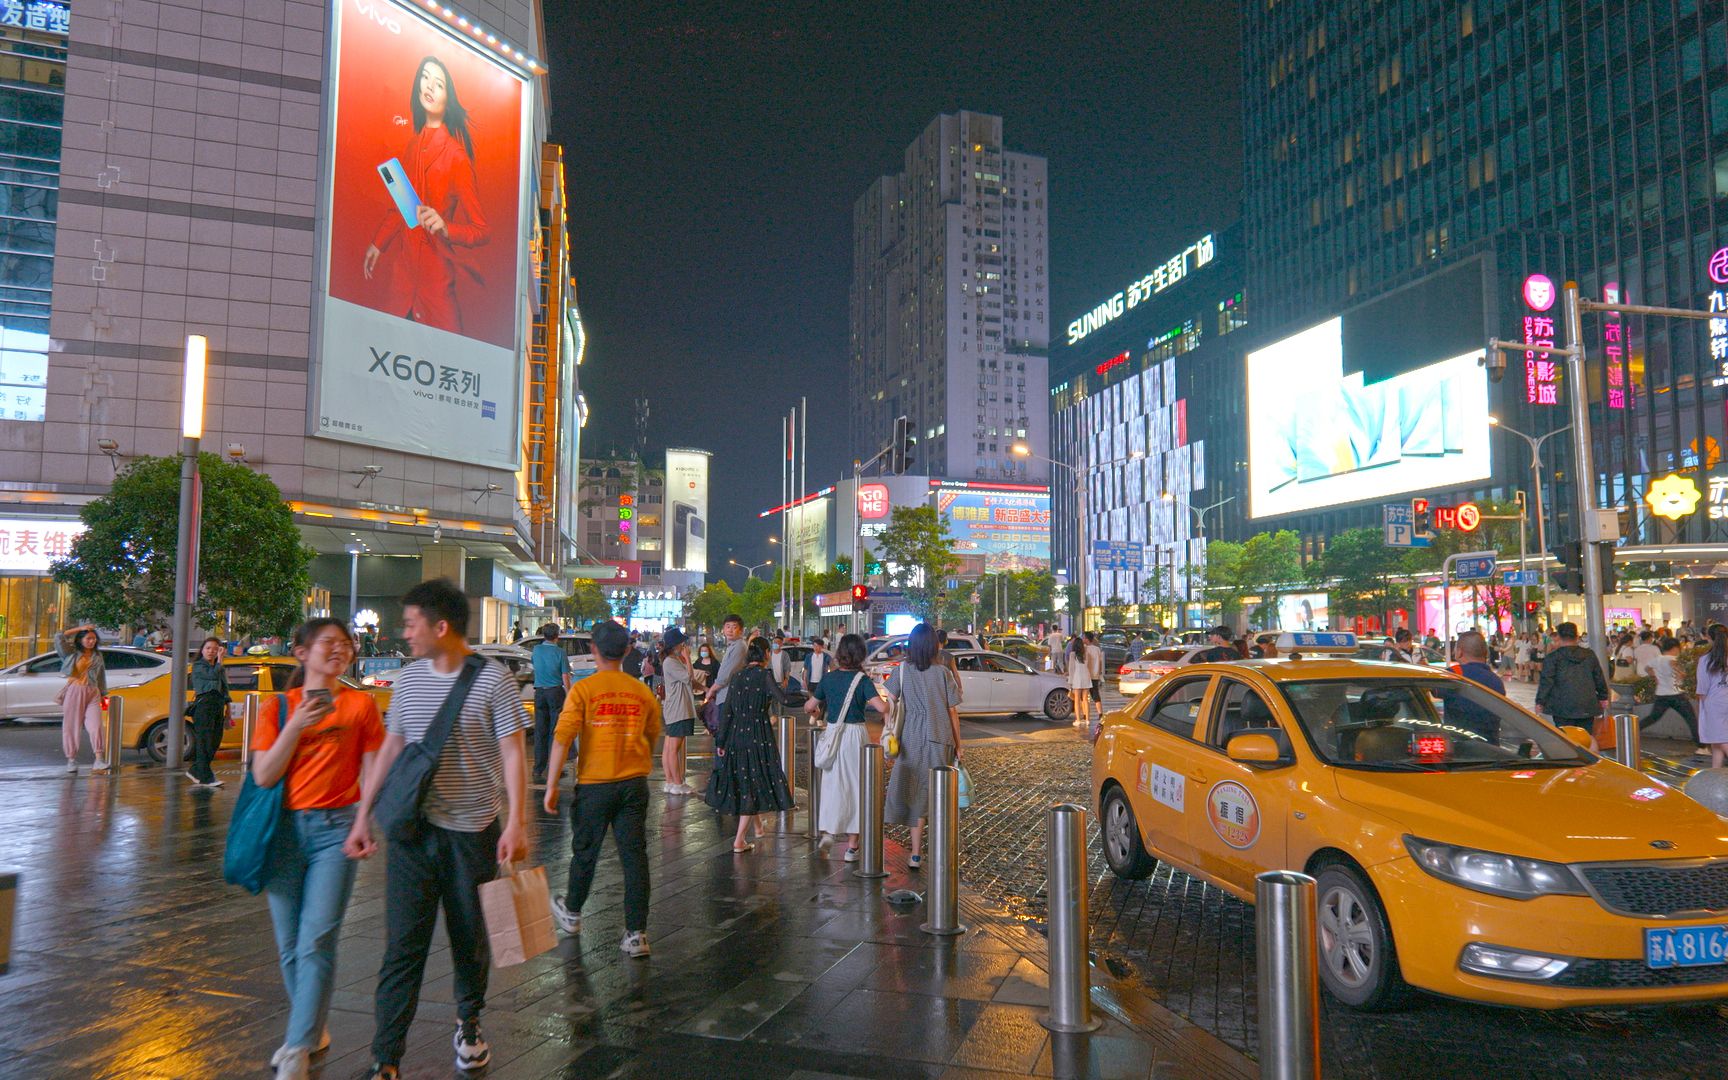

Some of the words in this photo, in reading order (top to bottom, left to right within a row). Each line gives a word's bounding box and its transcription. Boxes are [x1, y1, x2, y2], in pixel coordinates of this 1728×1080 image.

[355, 0, 401, 34] vivo
[1068, 291, 1124, 345] SUNING
[1127, 234, 1214, 309] 苏宁生活广场
[1524, 317, 1534, 358] SUNIG
[1534, 316, 1557, 404] 苏宁影城
[1526, 360, 1537, 403] CINEMA
[413, 390, 434, 400] vivo
[862, 489, 882, 500] GO
[863, 501, 882, 512] ME
[1436, 509, 1455, 528] 14
[1394, 526, 1405, 542] P
[1419, 738, 1446, 754] 空车
